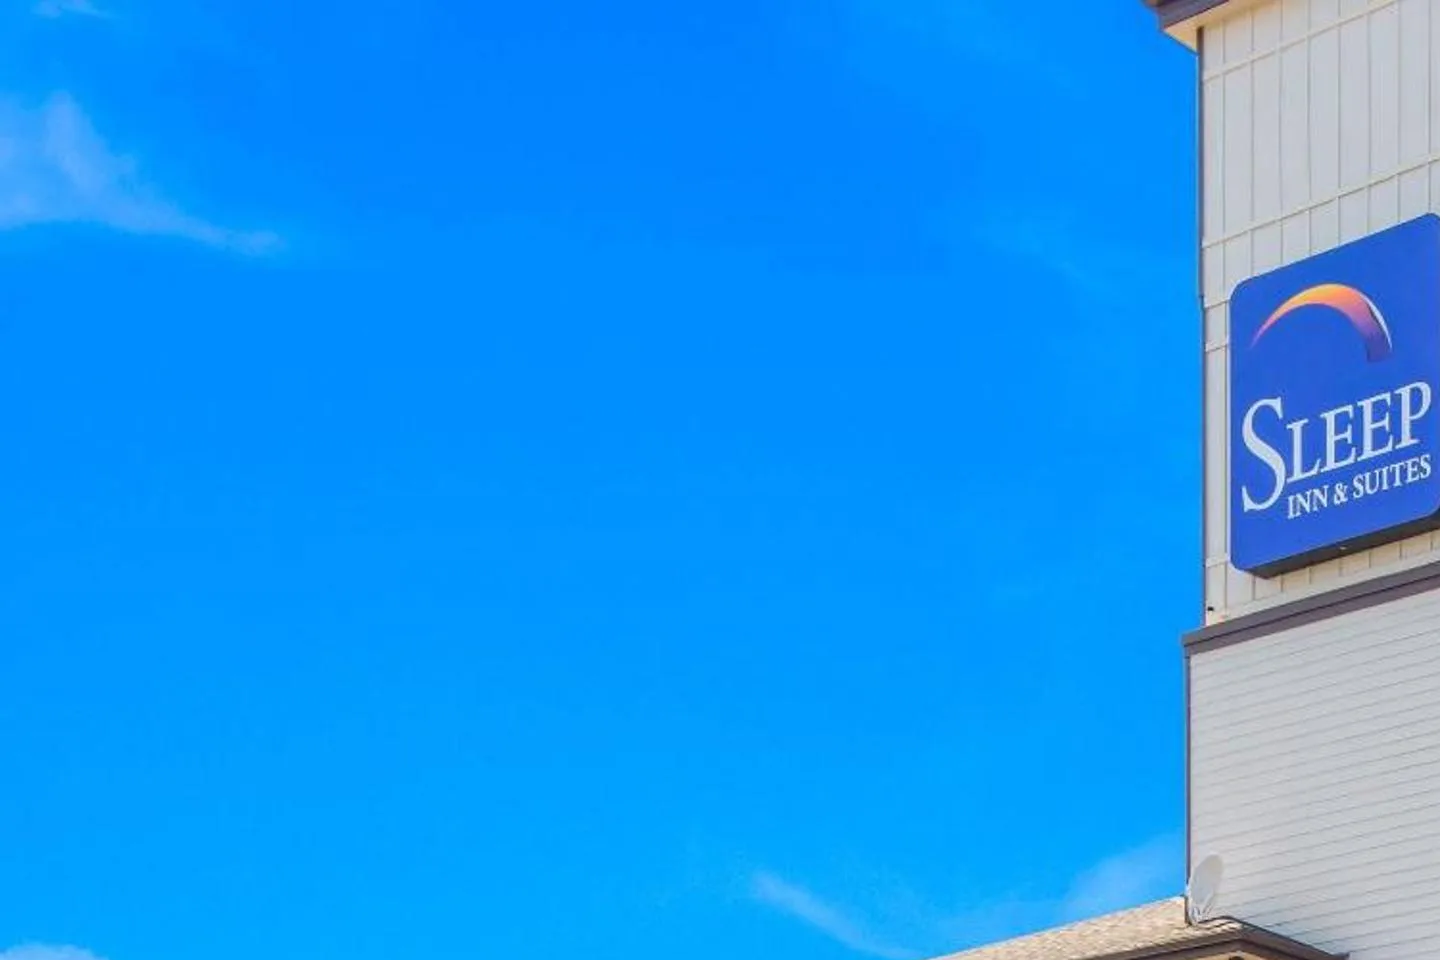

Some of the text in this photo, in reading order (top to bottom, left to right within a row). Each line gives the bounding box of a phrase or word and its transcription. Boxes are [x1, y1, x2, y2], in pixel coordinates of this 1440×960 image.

[1242, 381, 1432, 512] SLEEP
[1287, 455, 1432, 519] INN & SUITES
